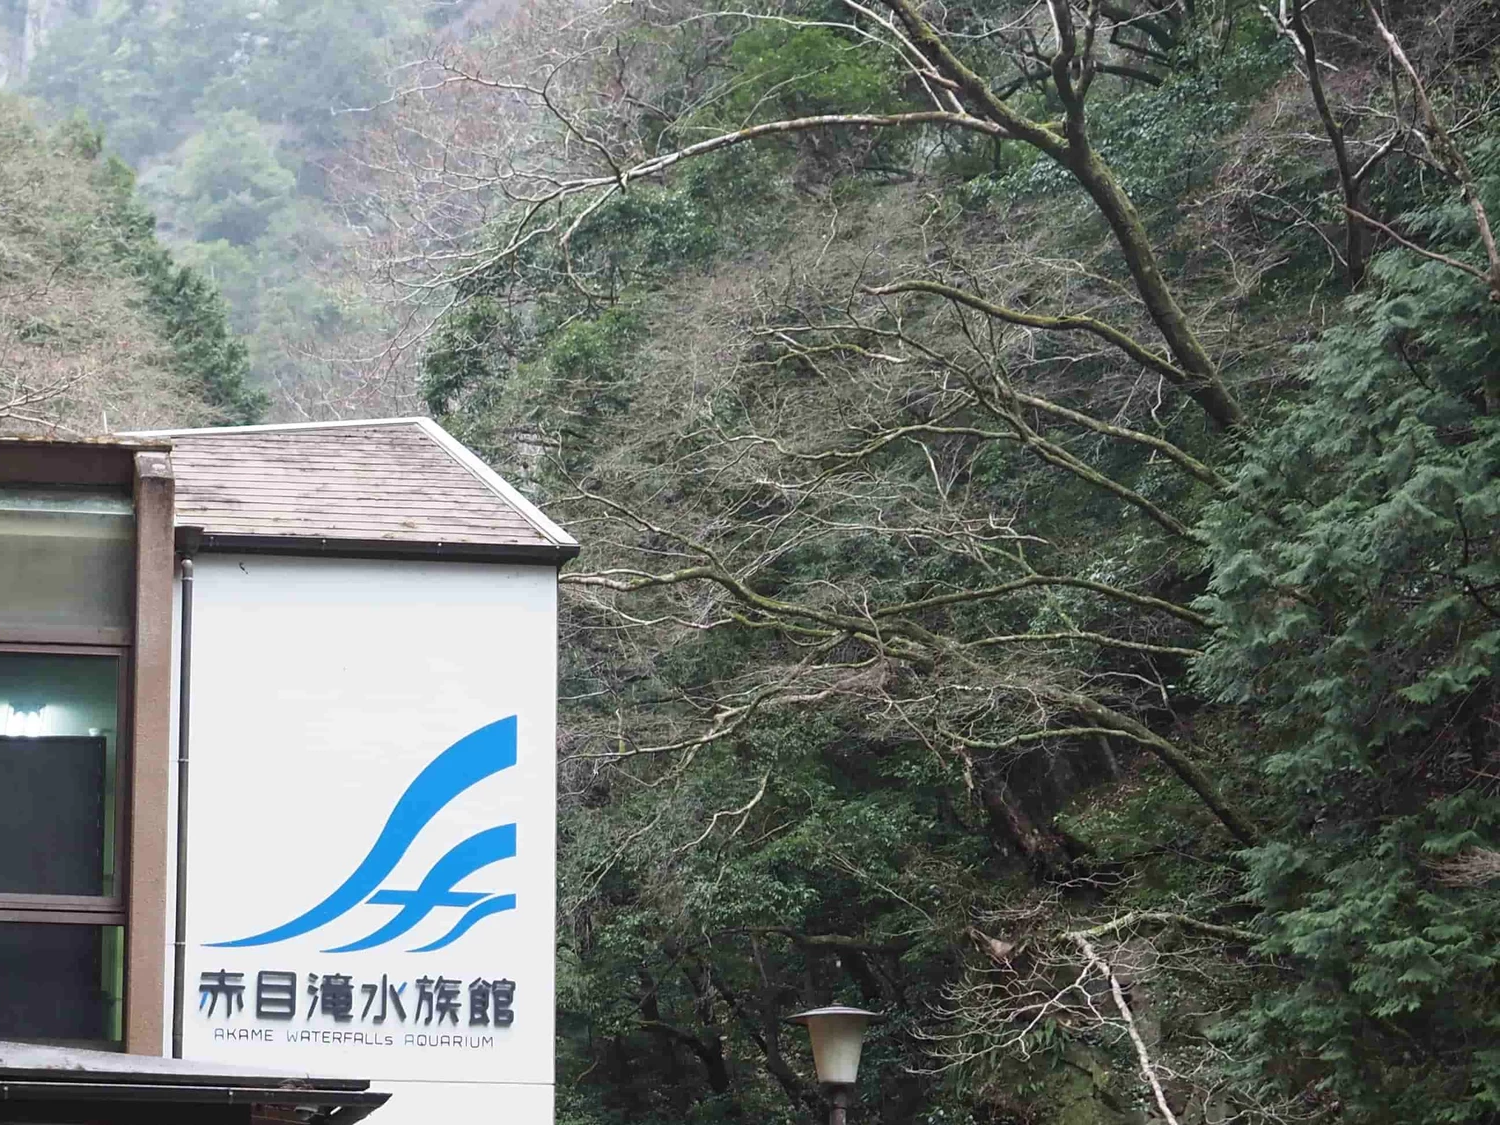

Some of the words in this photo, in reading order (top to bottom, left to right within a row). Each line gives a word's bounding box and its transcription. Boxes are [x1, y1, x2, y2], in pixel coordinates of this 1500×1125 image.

[199, 968, 516, 1029] 赤目滝水族館
[214, 1028, 274, 1042] AKAME
[404, 1033, 495, 1048] AQUARIUM
